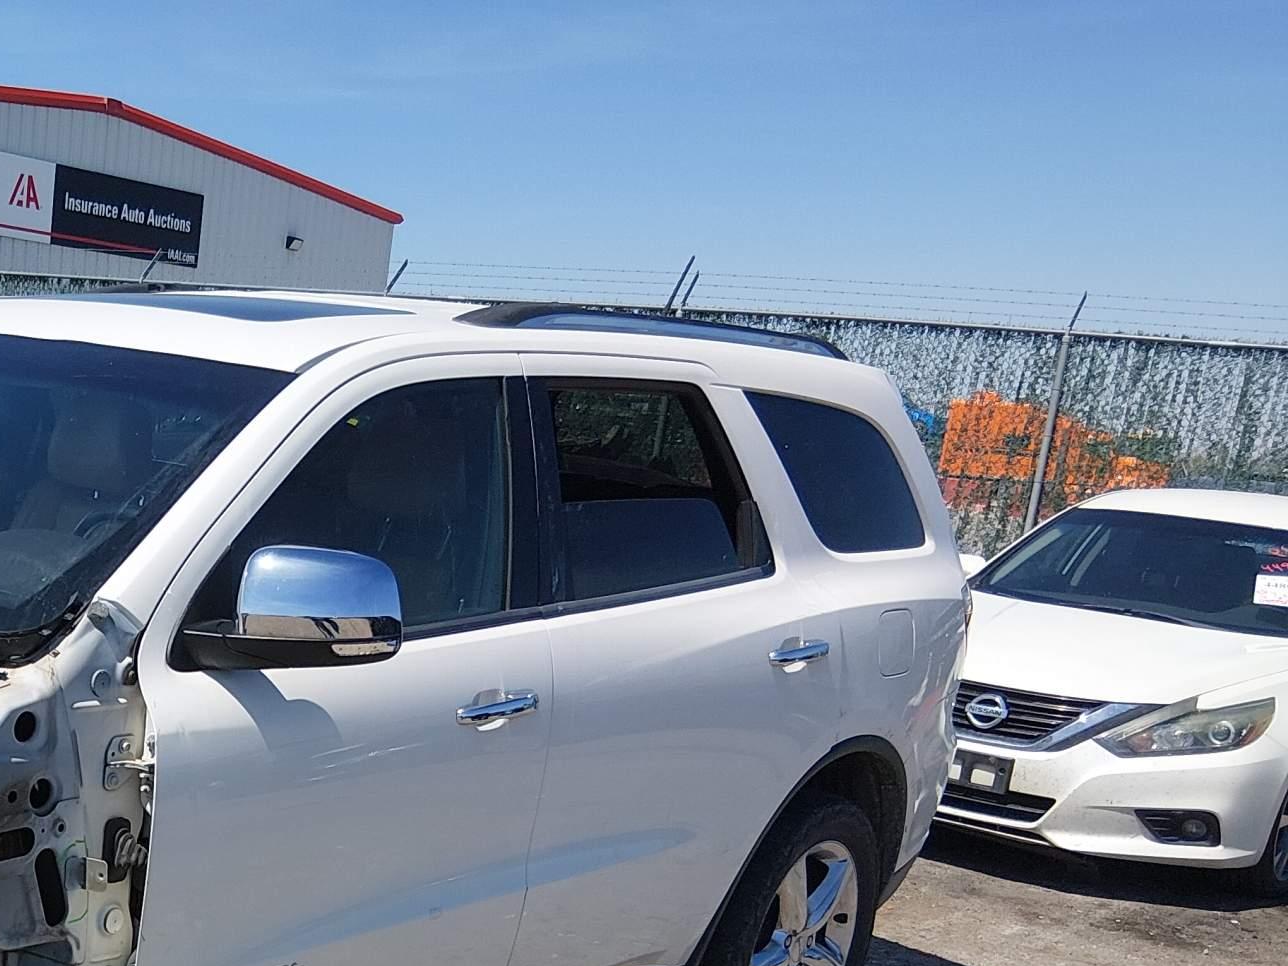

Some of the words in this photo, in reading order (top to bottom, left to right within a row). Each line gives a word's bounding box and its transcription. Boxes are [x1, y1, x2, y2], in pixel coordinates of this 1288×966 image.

[64, 191, 119, 219] Insurance
[120, 203, 145, 224] Auto
[147, 208, 191, 233] Auctions
[968, 704, 1002, 717] NISSAN
